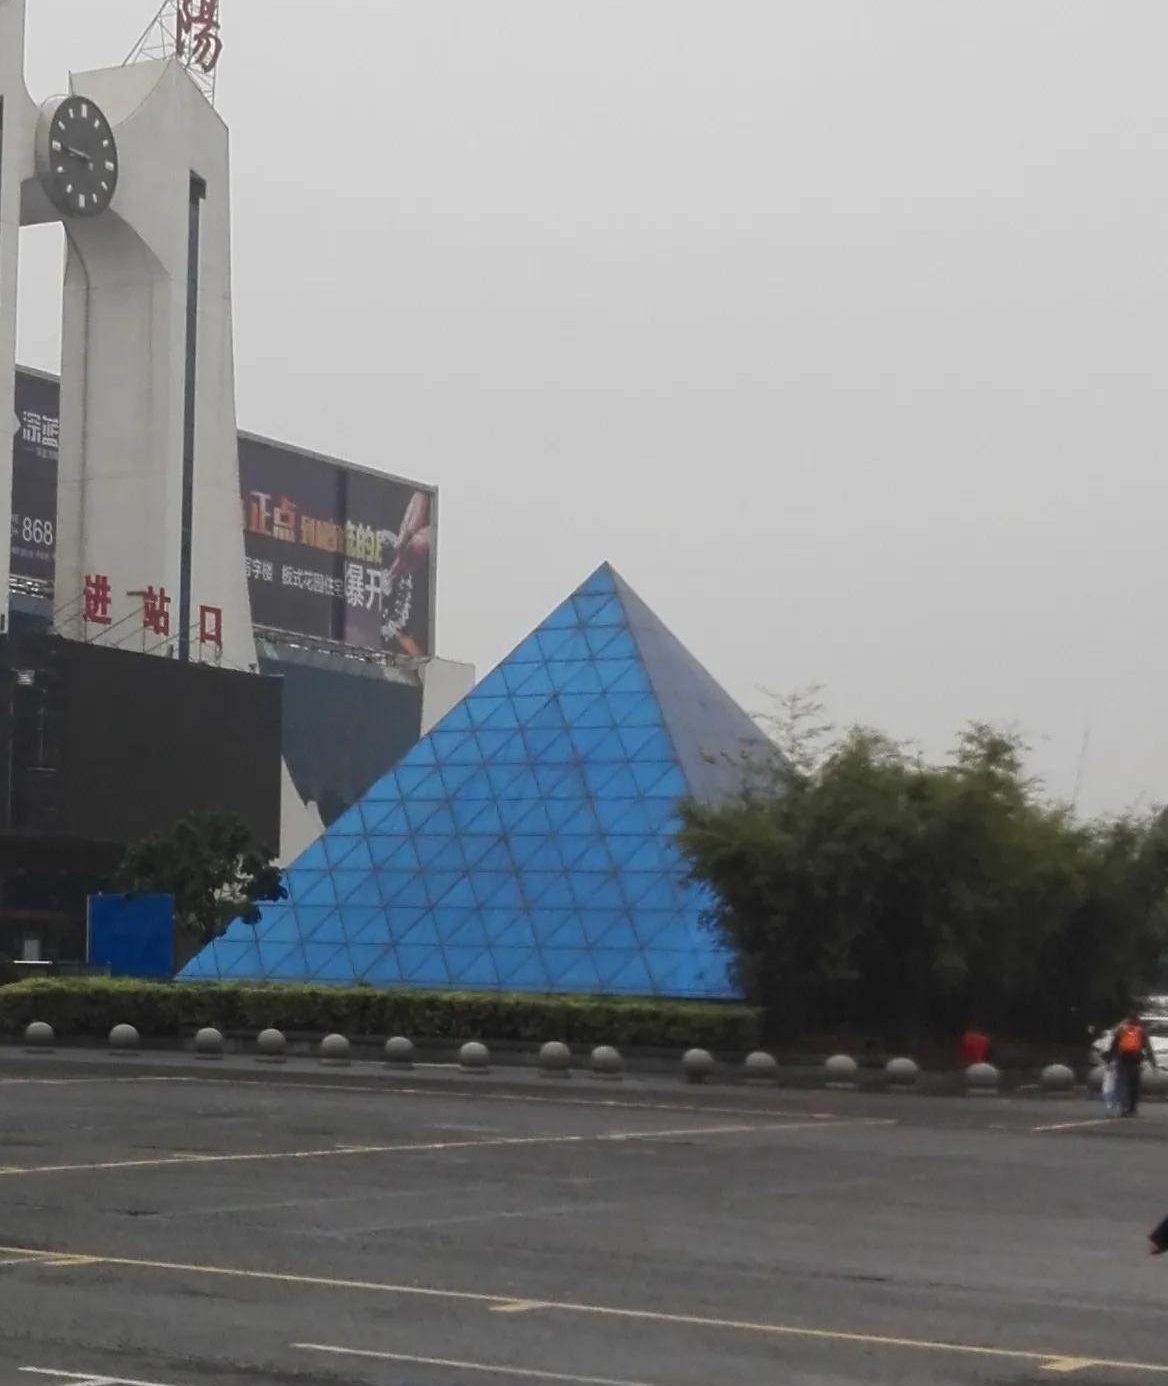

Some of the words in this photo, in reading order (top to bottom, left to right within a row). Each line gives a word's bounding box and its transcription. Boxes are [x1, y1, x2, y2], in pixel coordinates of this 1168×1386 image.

[21, 516, 54, 546] 868
[82, 574, 223, 648] 进站口
